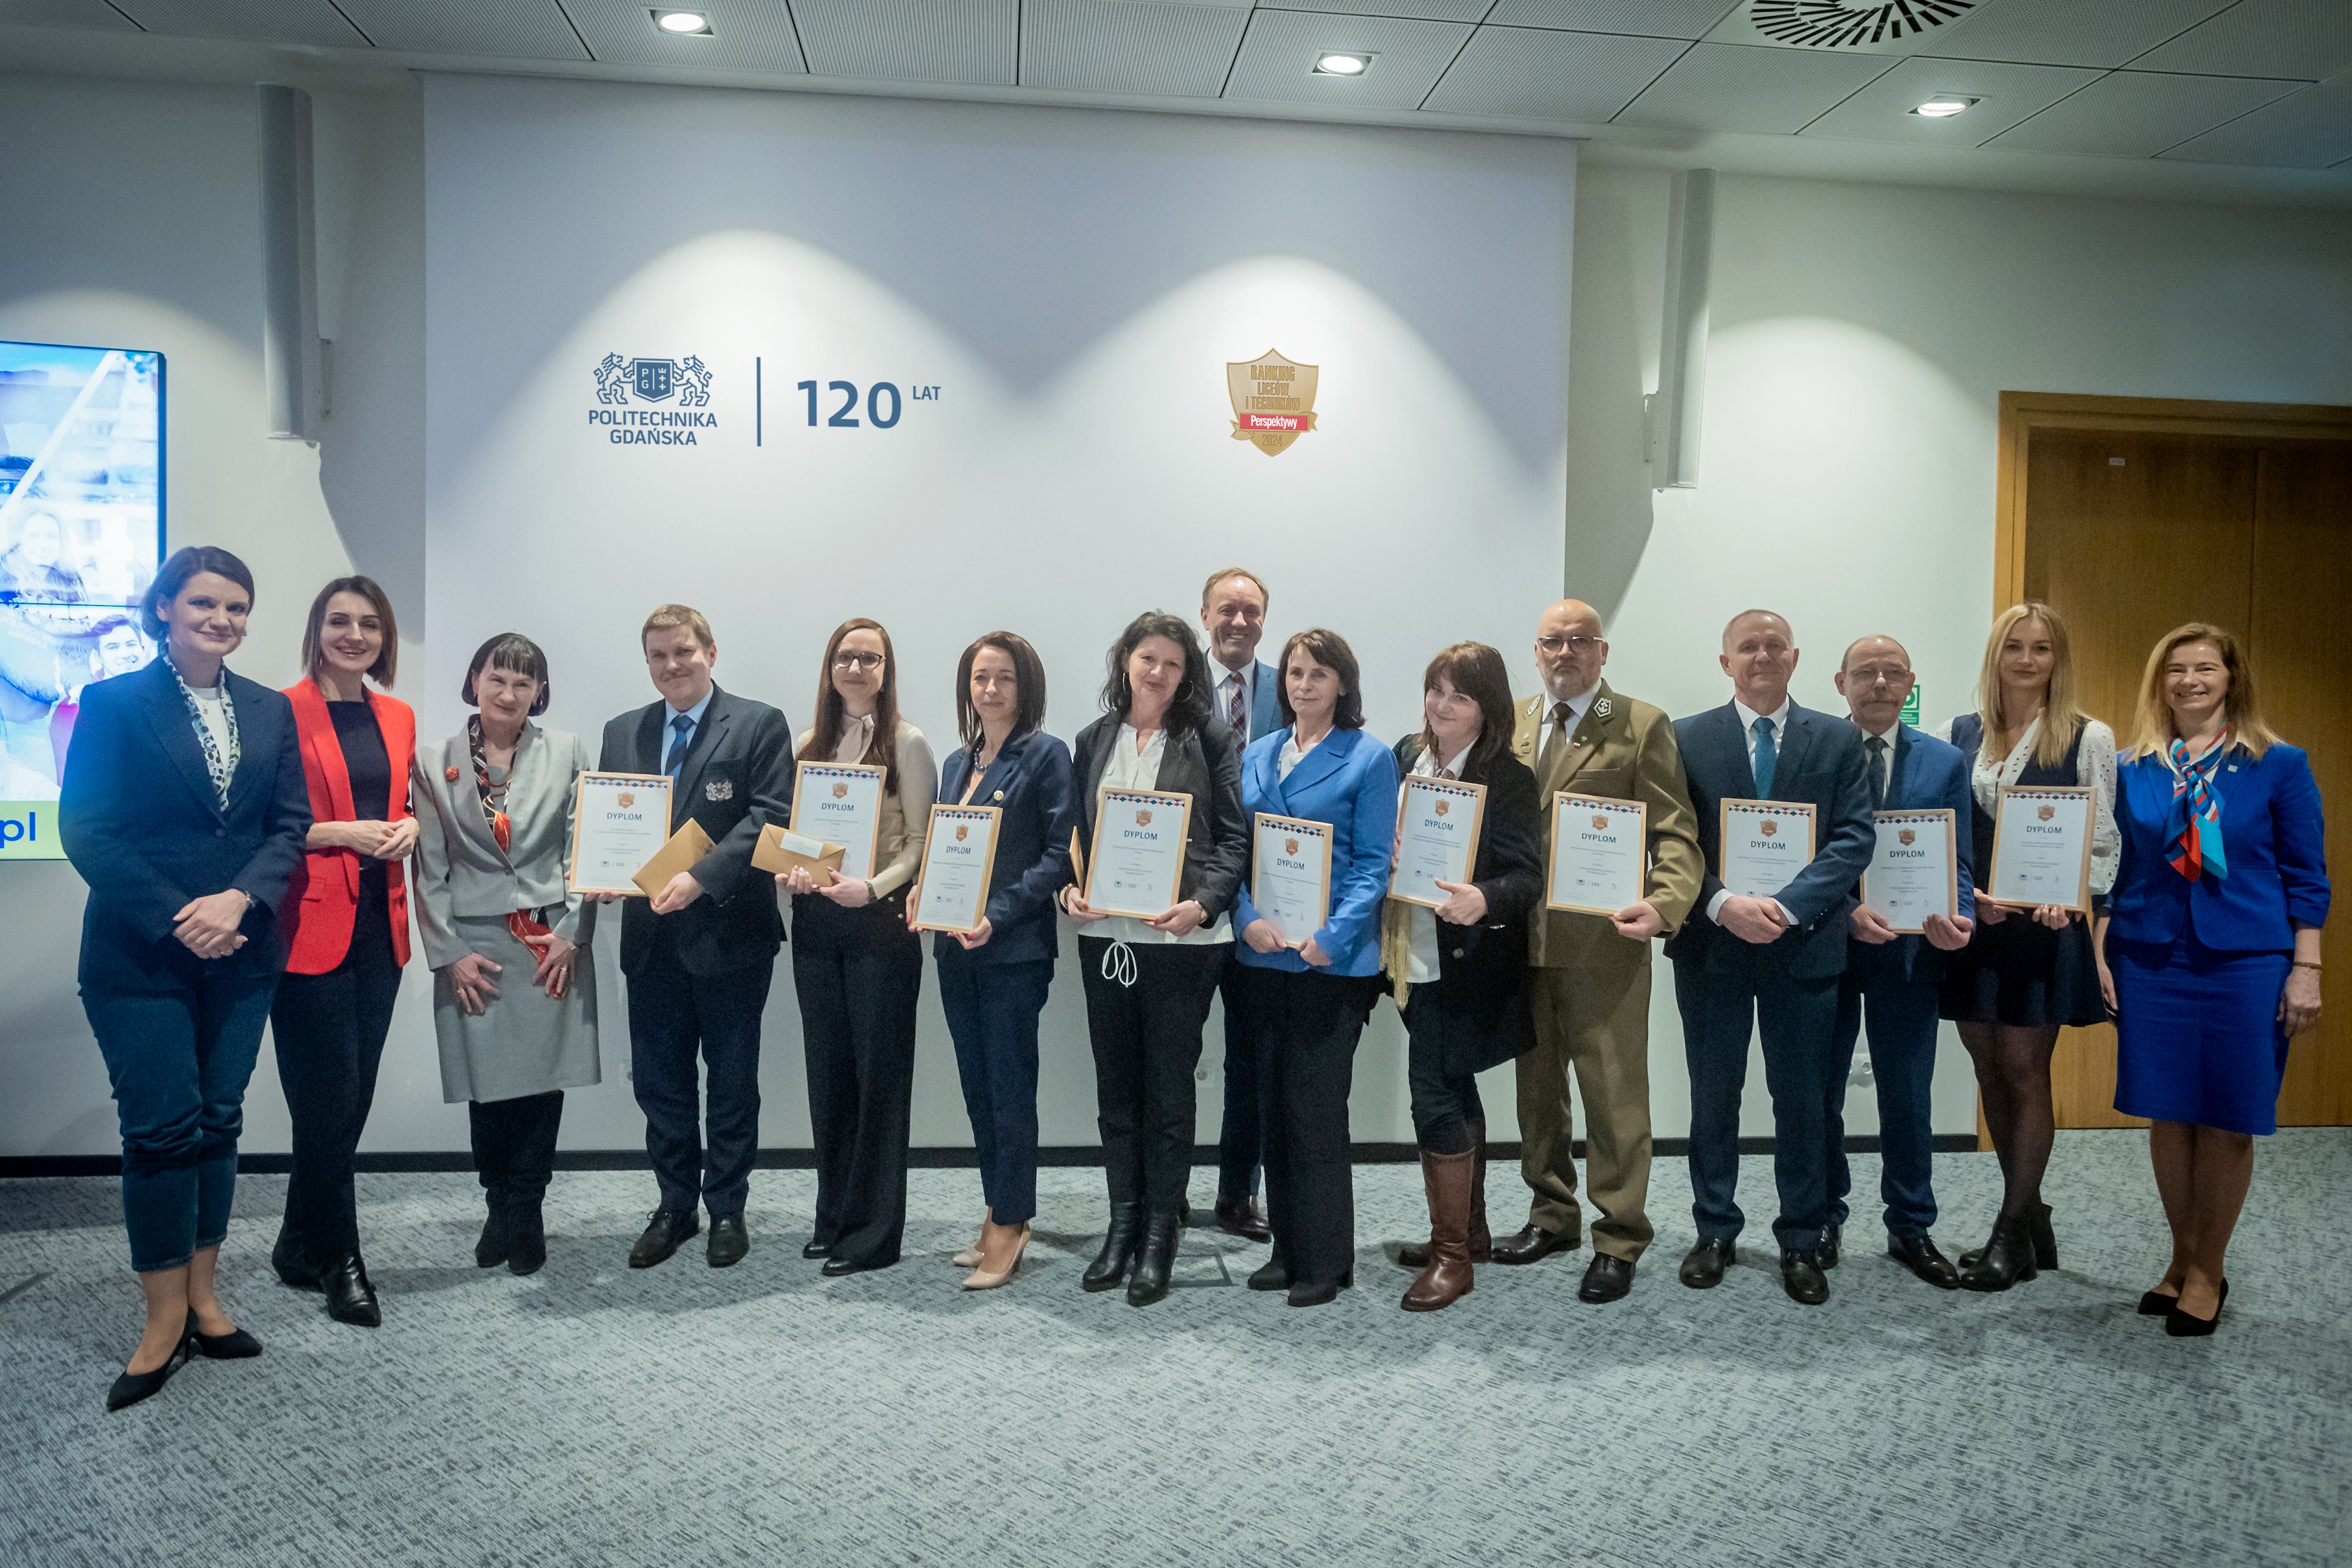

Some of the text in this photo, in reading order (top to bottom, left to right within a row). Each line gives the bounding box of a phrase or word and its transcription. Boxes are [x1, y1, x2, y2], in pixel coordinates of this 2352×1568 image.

[642, 368, 649, 377] P
[1250, 365, 1295, 382] RANKING
[642, 379, 649, 389] G
[1257, 380, 1289, 396] LICEÓW
[797, 380, 941, 429] 120 LAT
[1251, 395, 1301, 410] TECHNIKÓW
[589, 410, 717, 427] POLITECHNIKA
[1251, 415, 1298, 429] Perspektywy
[610, 427, 697, 446] GDAŃSKA
[1262, 433, 1283, 446] 2024
[821, 803, 854, 811] DYPLOM
[607, 812, 642, 821] DYPLOM
[1424, 819, 1454, 831] DYPLOM
[2026, 825, 2062, 834] DYPLOM
[1124, 830, 1158, 840] DYPLOM
[1582, 833, 1616, 843] DYPLOM
[946, 846, 971, 854] DYPLOM
[1750, 841, 1786, 850] DYPLOM
[1277, 858, 1305, 870] DYPLOM
